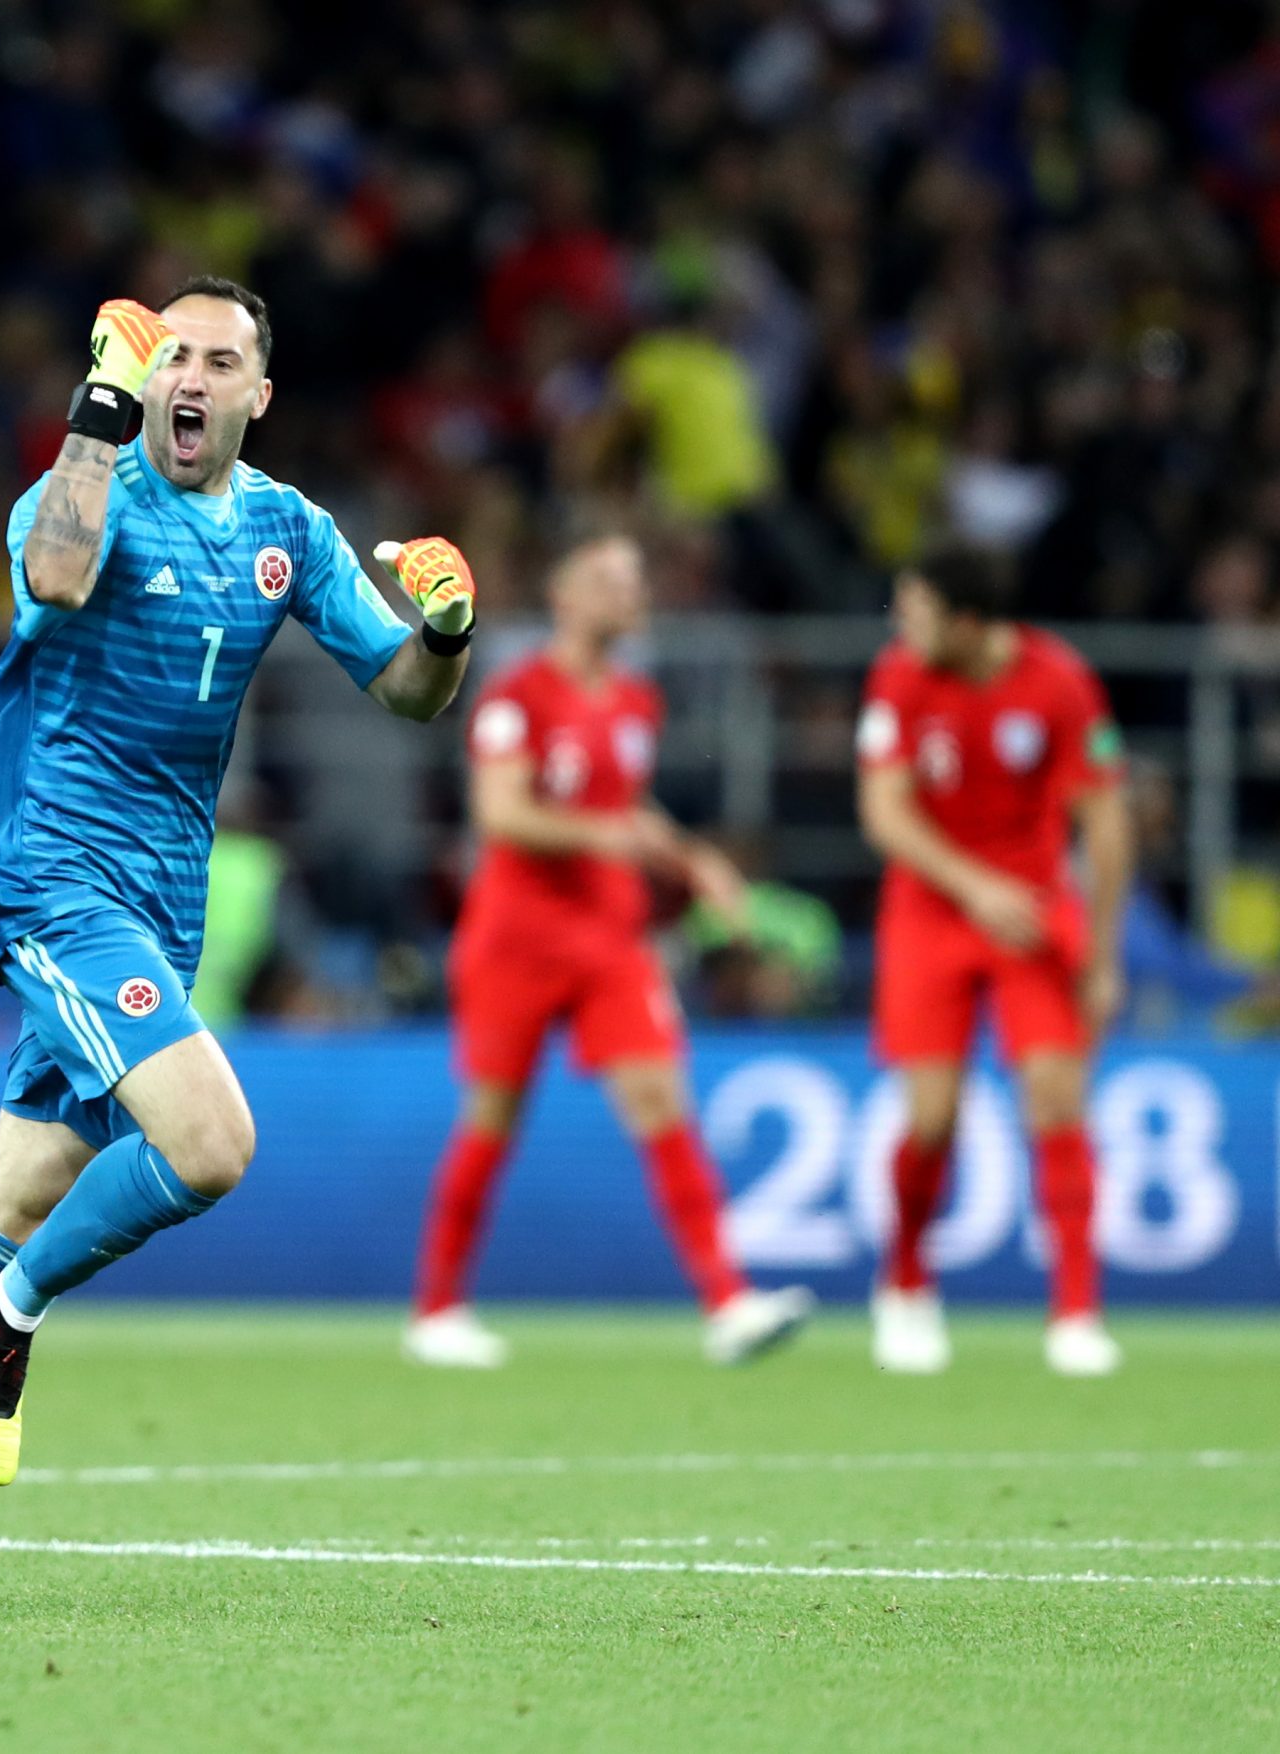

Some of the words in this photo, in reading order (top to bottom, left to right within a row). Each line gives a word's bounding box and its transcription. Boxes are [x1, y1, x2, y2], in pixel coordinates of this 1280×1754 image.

[144, 582, 181, 596] adidas
[197, 626, 224, 702] 1
[703, 1056, 1241, 1273] 208
